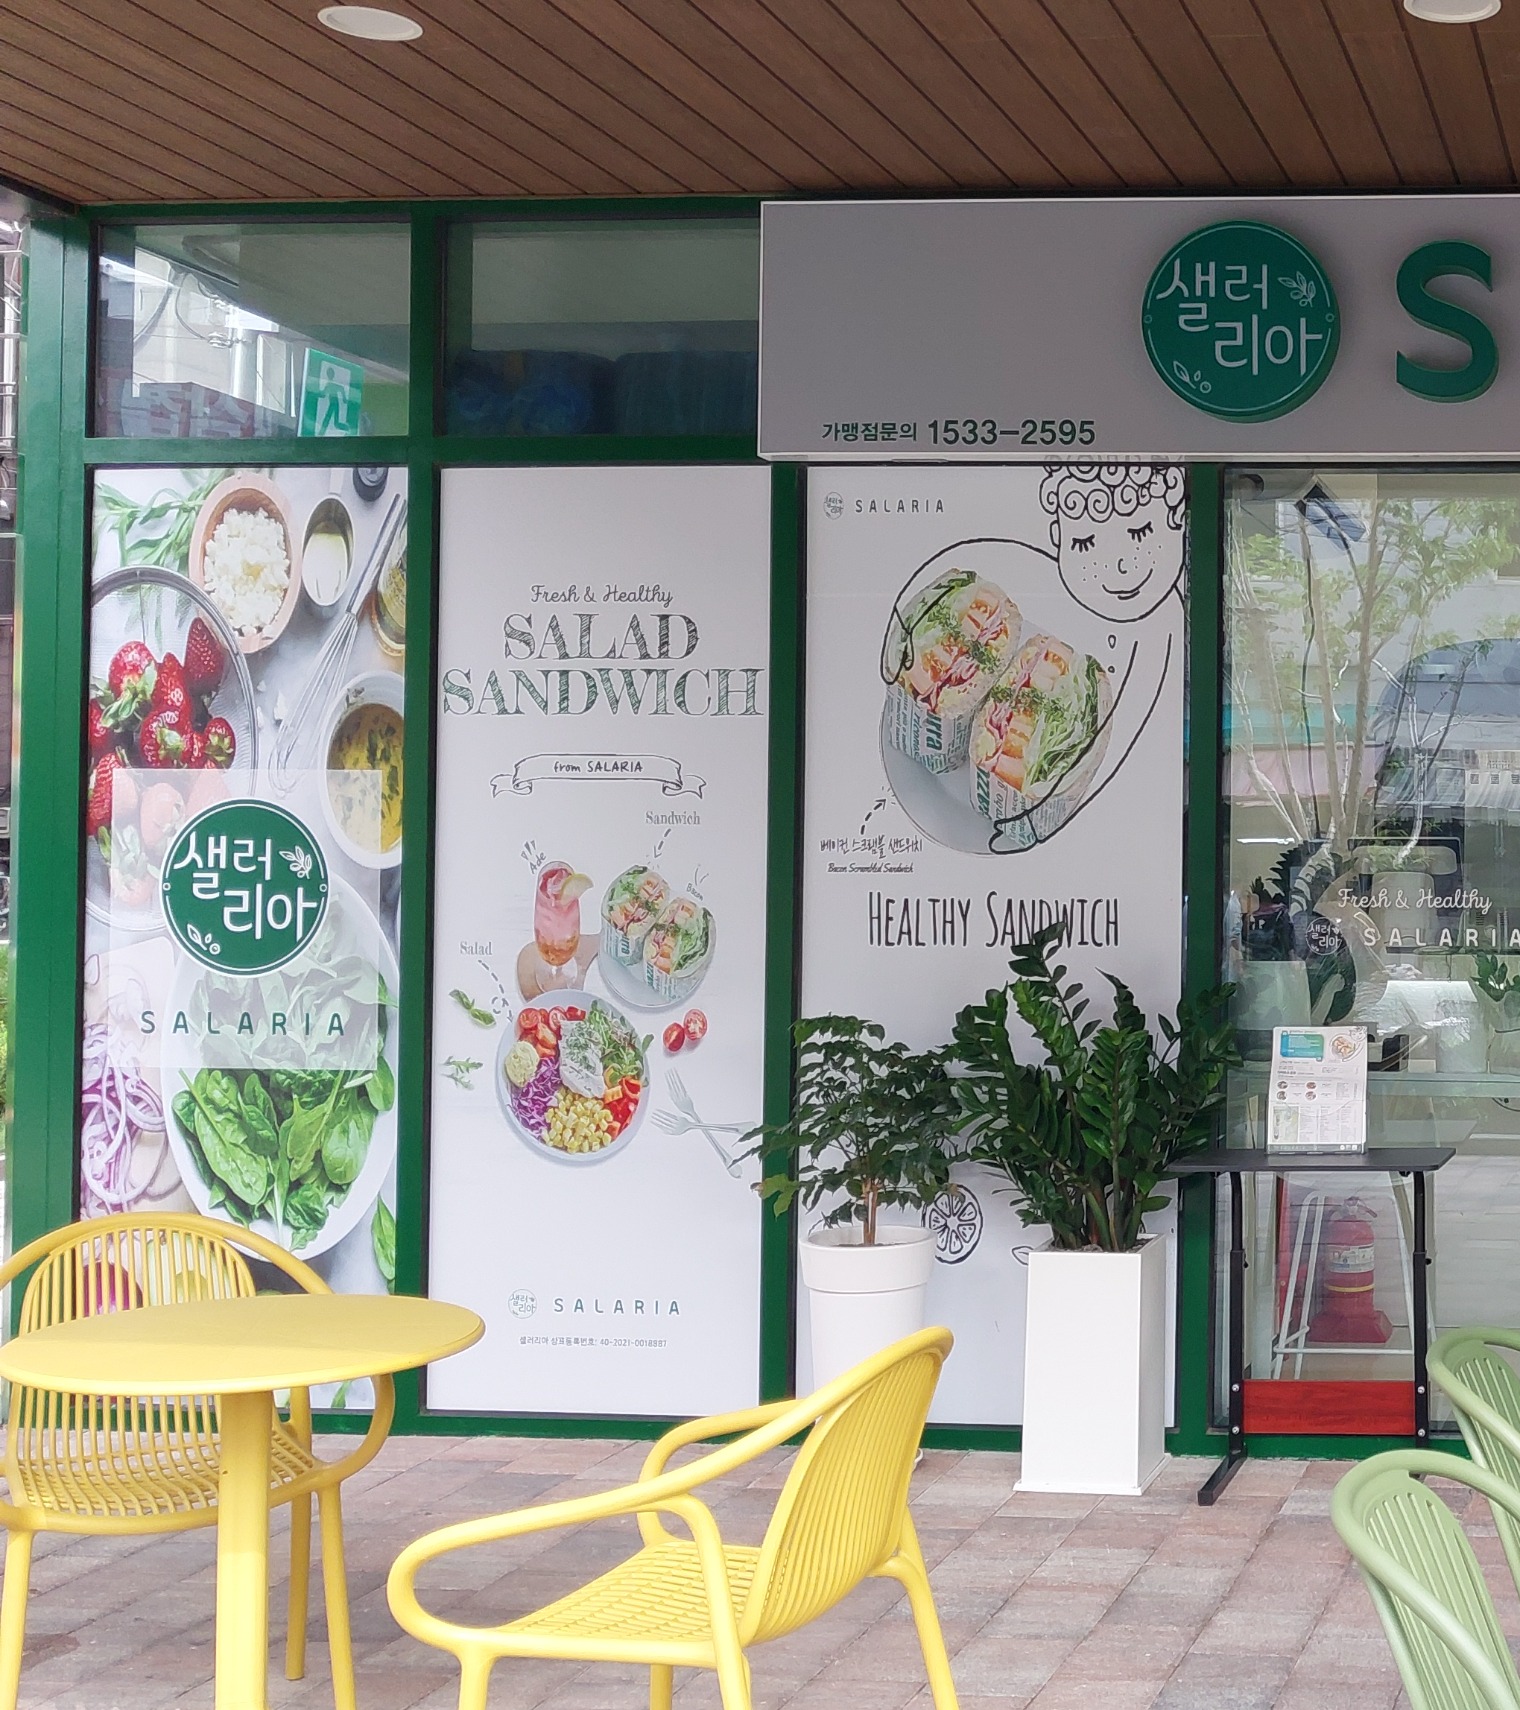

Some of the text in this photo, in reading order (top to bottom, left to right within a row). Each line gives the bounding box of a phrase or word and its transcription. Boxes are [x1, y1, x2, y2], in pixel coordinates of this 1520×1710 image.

[1156, 257, 1268, 332] 샐러
[1214, 313, 1323, 377] 리아
[821, 419, 1096, 445] 가맹점문의 1533-2595
[855, 499, 944, 513] SALARIA
[530, 584, 674, 608] Fresh & Healthy
[504, 613, 700, 660] SALAD
[442, 667, 765, 716] SANDWICH
[553, 761, 643, 773] from SALARIA
[645, 811, 701, 825] Sandwich
[173, 831, 272, 899] 샐러
[529, 853, 548, 875] Ade
[223, 883, 318, 943] 리아
[1337, 888, 1493, 915] Fresh & Healthy
[868, 891, 1119, 948] HEALTHY SANDWICH
[459, 941, 493, 956] Salad
[140, 1010, 345, 1036] SALARIA
[553, 1298, 680, 1315] SALARIA
